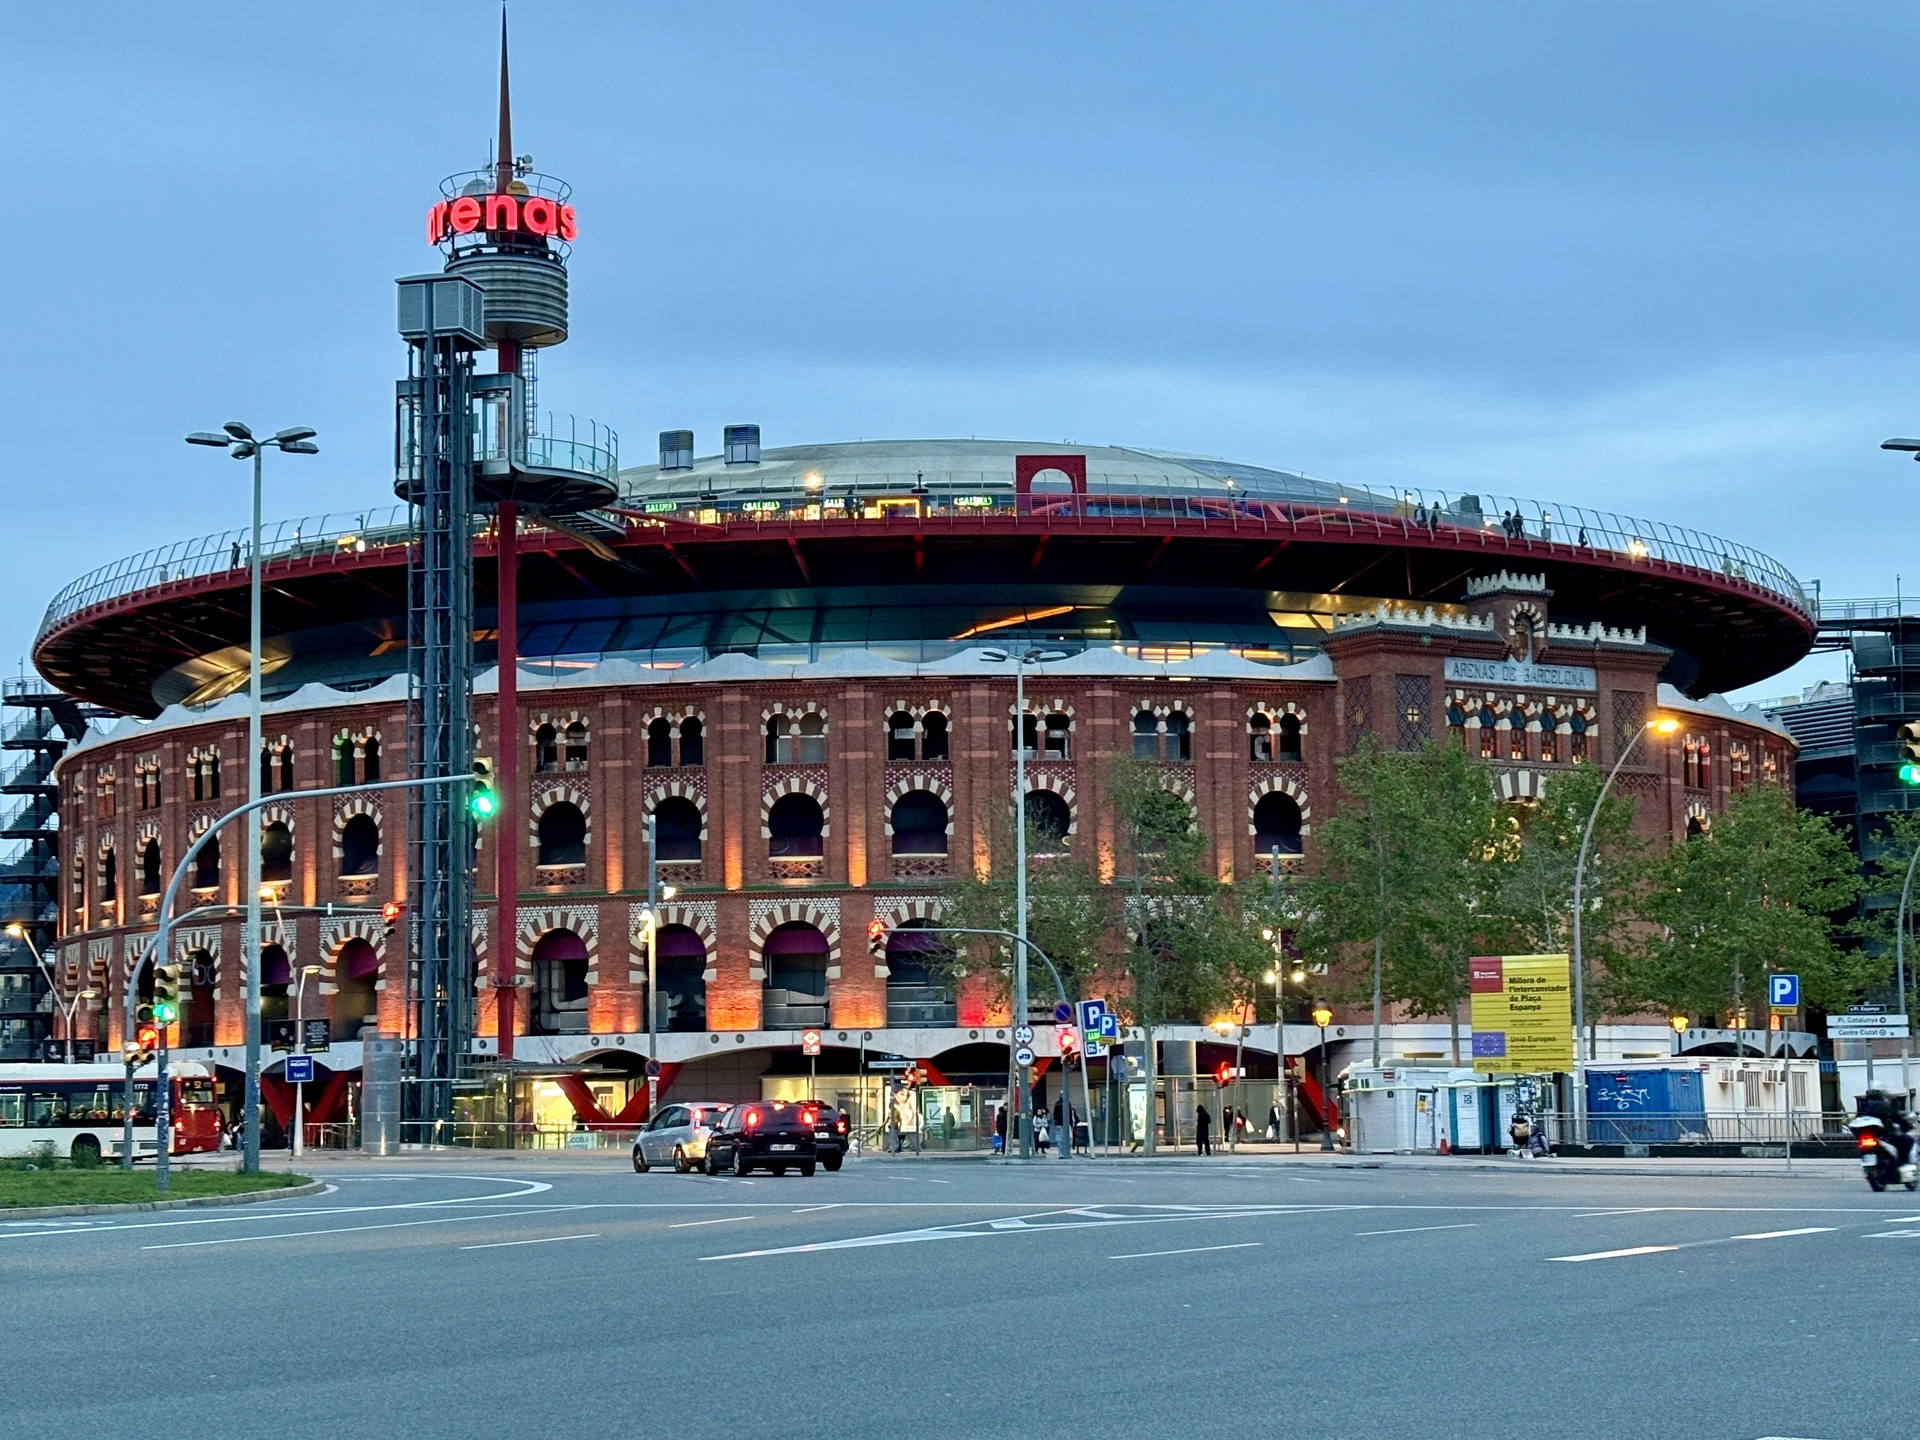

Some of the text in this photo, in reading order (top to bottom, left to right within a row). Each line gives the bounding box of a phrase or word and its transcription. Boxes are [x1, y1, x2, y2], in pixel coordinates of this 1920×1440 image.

[1452, 662, 1586, 687] ARENAS DE BARCELONA
[1537, 976, 1547, 984] de
[1521, 995, 1542, 1003] Plaça
[1774, 978, 1792, 1002] P
[1088, 1006, 1100, 1025] P
[1510, 1004, 1541, 1012] Espanya
[1101, 1016, 1113, 1034] P
